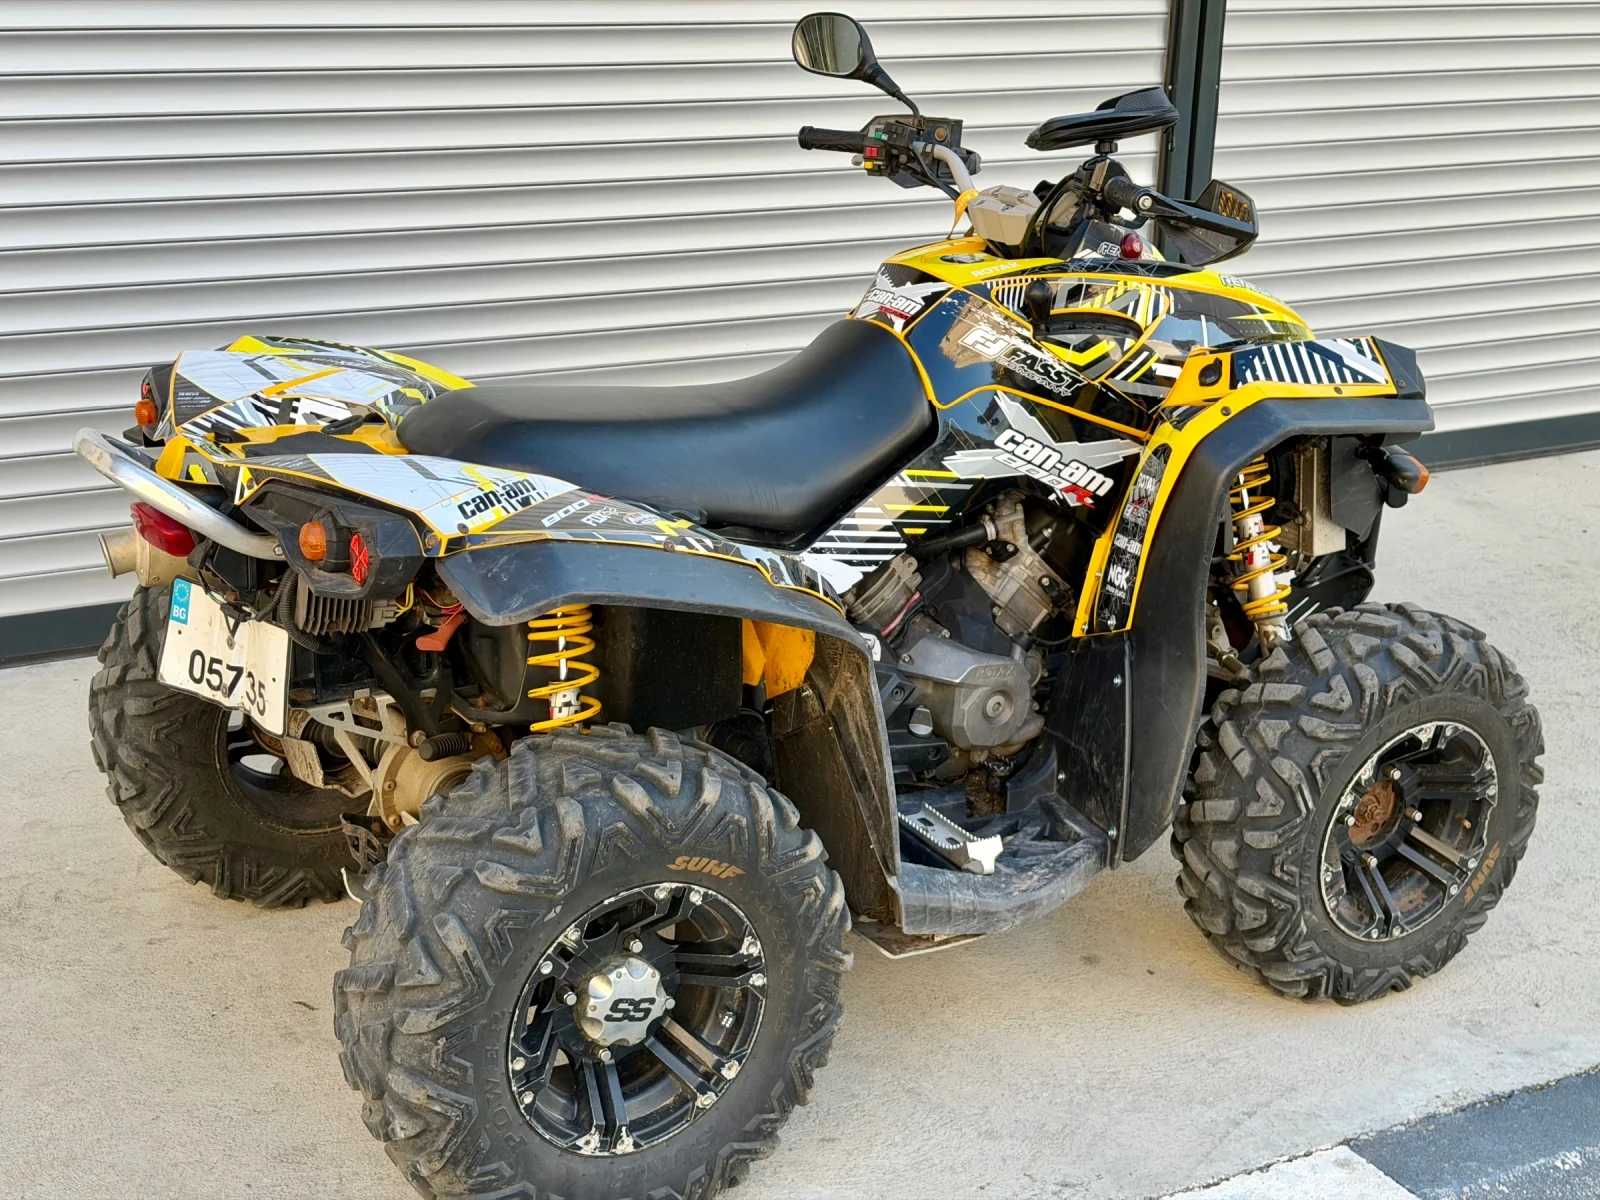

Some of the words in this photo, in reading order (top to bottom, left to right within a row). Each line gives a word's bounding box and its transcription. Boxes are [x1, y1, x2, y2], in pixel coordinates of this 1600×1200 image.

[971, 261, 1022, 278] ROTAX
[867, 288, 922, 315] can-am
[995, 357, 1073, 398] COMPANY
[1002, 345, 1088, 392] FASST
[993, 428, 1115, 498] can-am
[457, 478, 537, 521] can-am
[1113, 532, 1143, 557] can-am
[1107, 563, 1130, 591] NGK
[172, 604, 187, 620] BG
[188, 648, 267, 717] 05735
[666, 855, 746, 879] SUNF
[1463, 840, 1500, 909] SUNF
